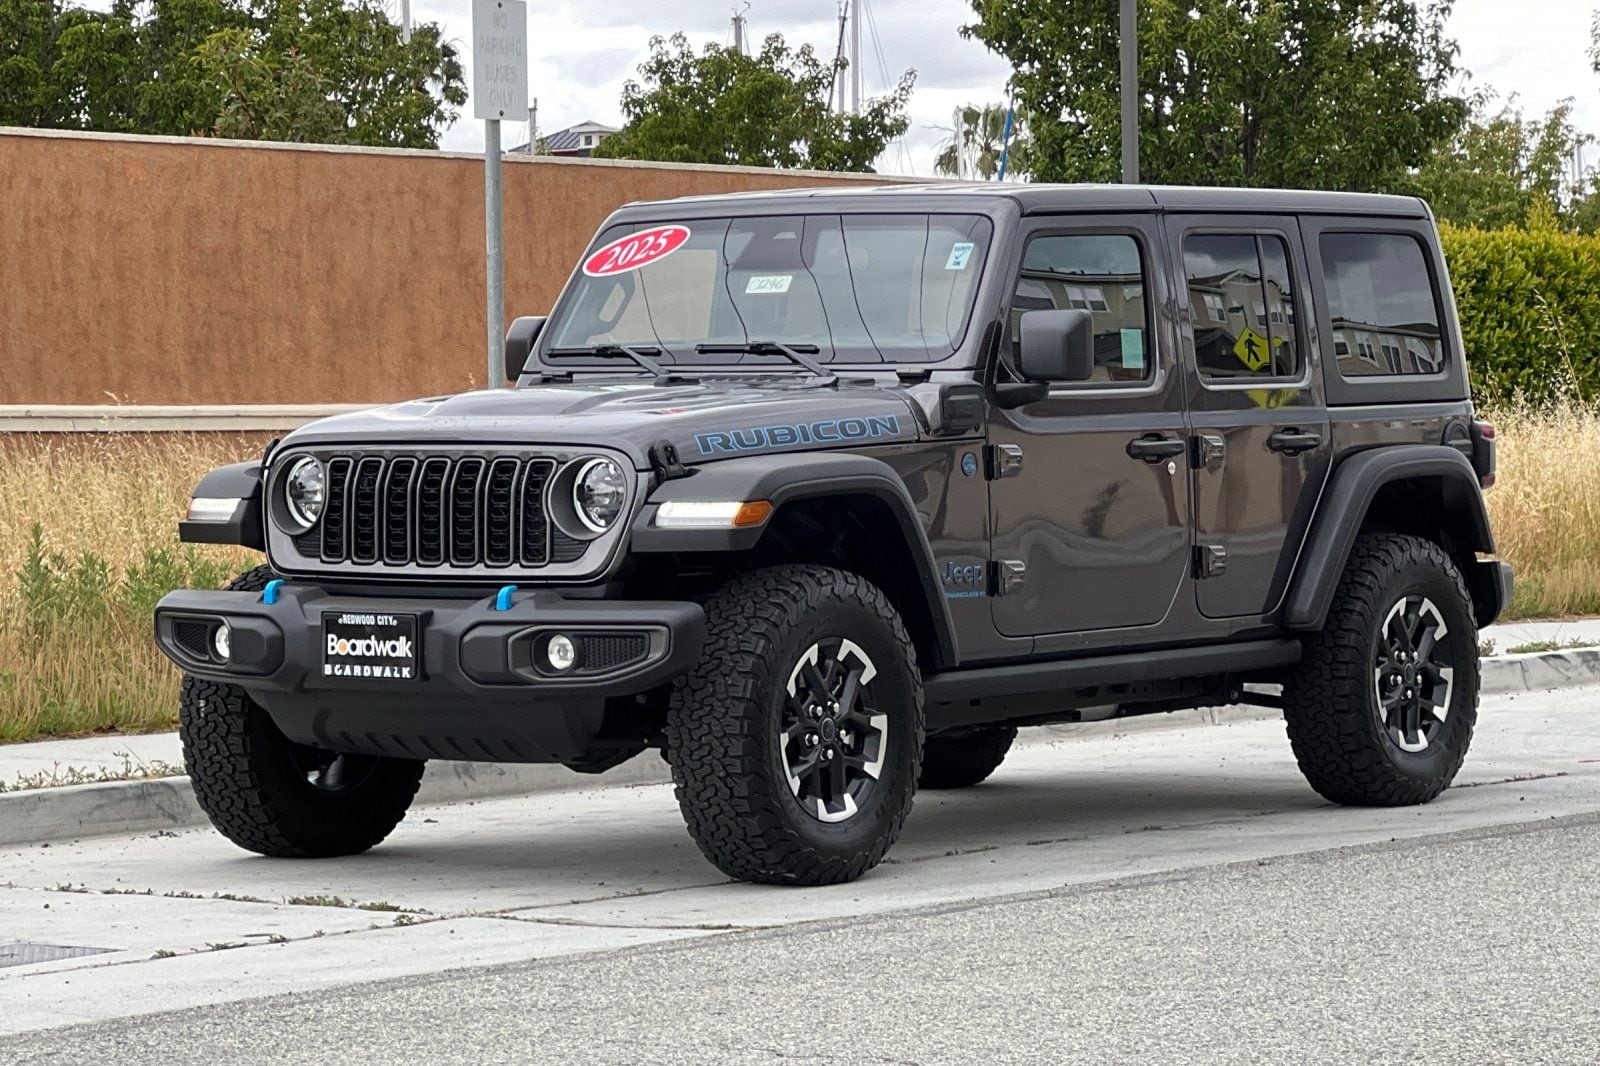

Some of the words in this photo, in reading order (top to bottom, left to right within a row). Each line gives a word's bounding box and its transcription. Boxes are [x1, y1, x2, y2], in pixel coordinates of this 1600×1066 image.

[479, 34, 522, 57] PARKING
[485, 63, 519, 85] BUSES
[489, 88, 515, 108] ONLY
[602, 234, 669, 270] 2025
[694, 415, 901, 454] RUBICON
[940, 561, 982, 588] Jeep
[342, 614, 375, 625] REDWOOD
[377, 615, 394, 626] CITY
[327, 633, 413, 658] Boardwalk
